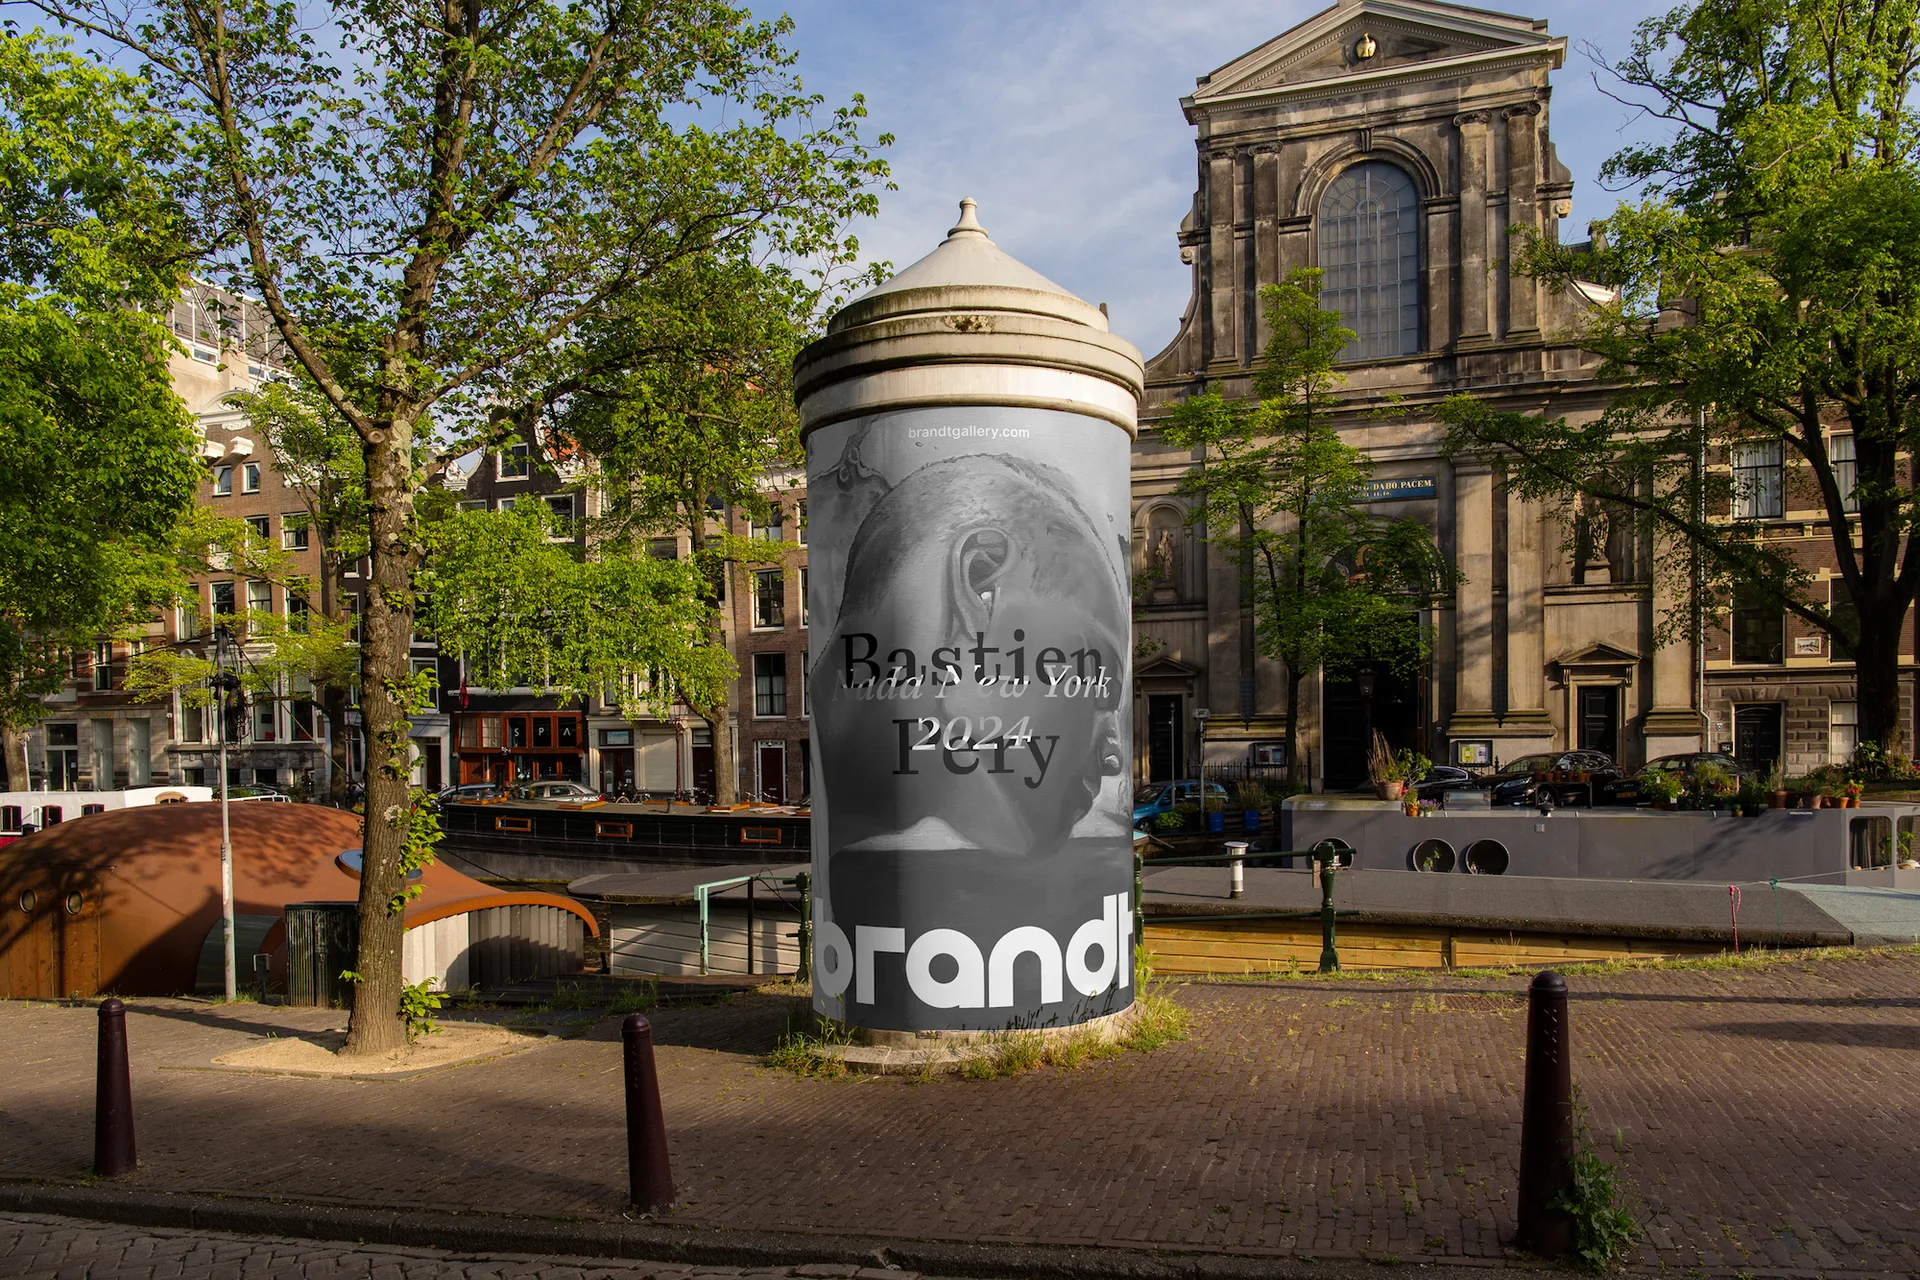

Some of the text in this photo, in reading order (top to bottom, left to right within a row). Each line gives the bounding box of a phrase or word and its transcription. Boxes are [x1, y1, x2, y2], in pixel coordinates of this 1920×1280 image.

[908, 425, 1030, 439] brandtgallery.com
[840, 629, 1103, 689] Bastien
[832, 665, 1112, 701] Nada New York
[514, 727, 571, 737] SPA
[912, 715, 1033, 751] 2024
[814, 892, 1134, 1009] brandt
